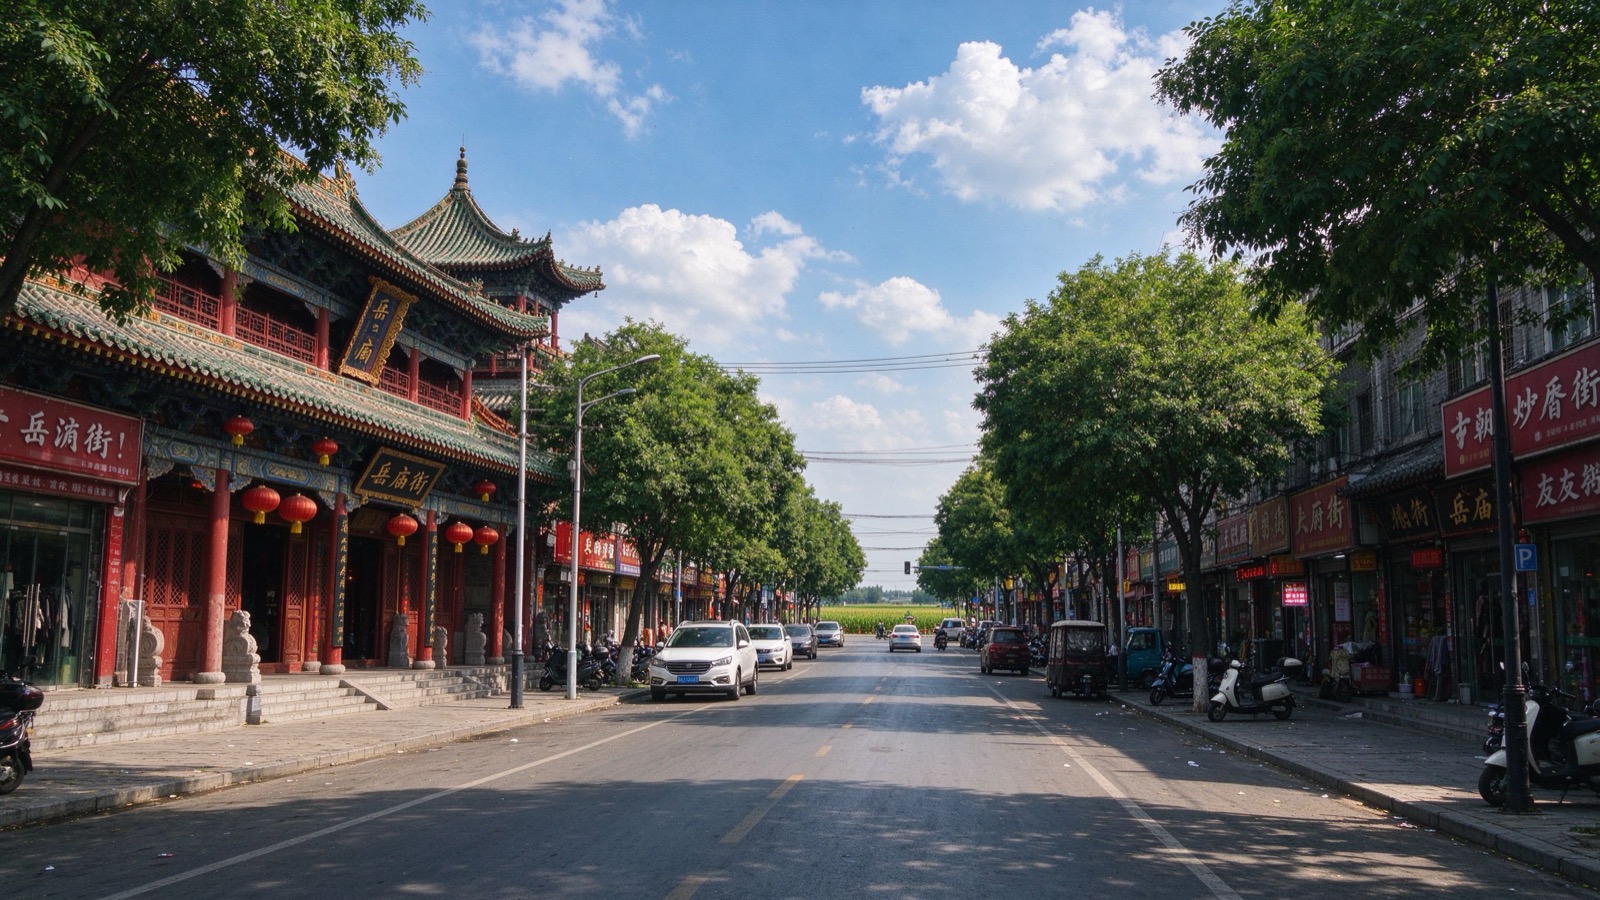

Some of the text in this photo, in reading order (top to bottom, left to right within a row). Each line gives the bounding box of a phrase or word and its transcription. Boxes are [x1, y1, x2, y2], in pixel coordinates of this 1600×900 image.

[370, 461, 430, 496] 岳庙街
[1518, 548, 1533, 568] P
